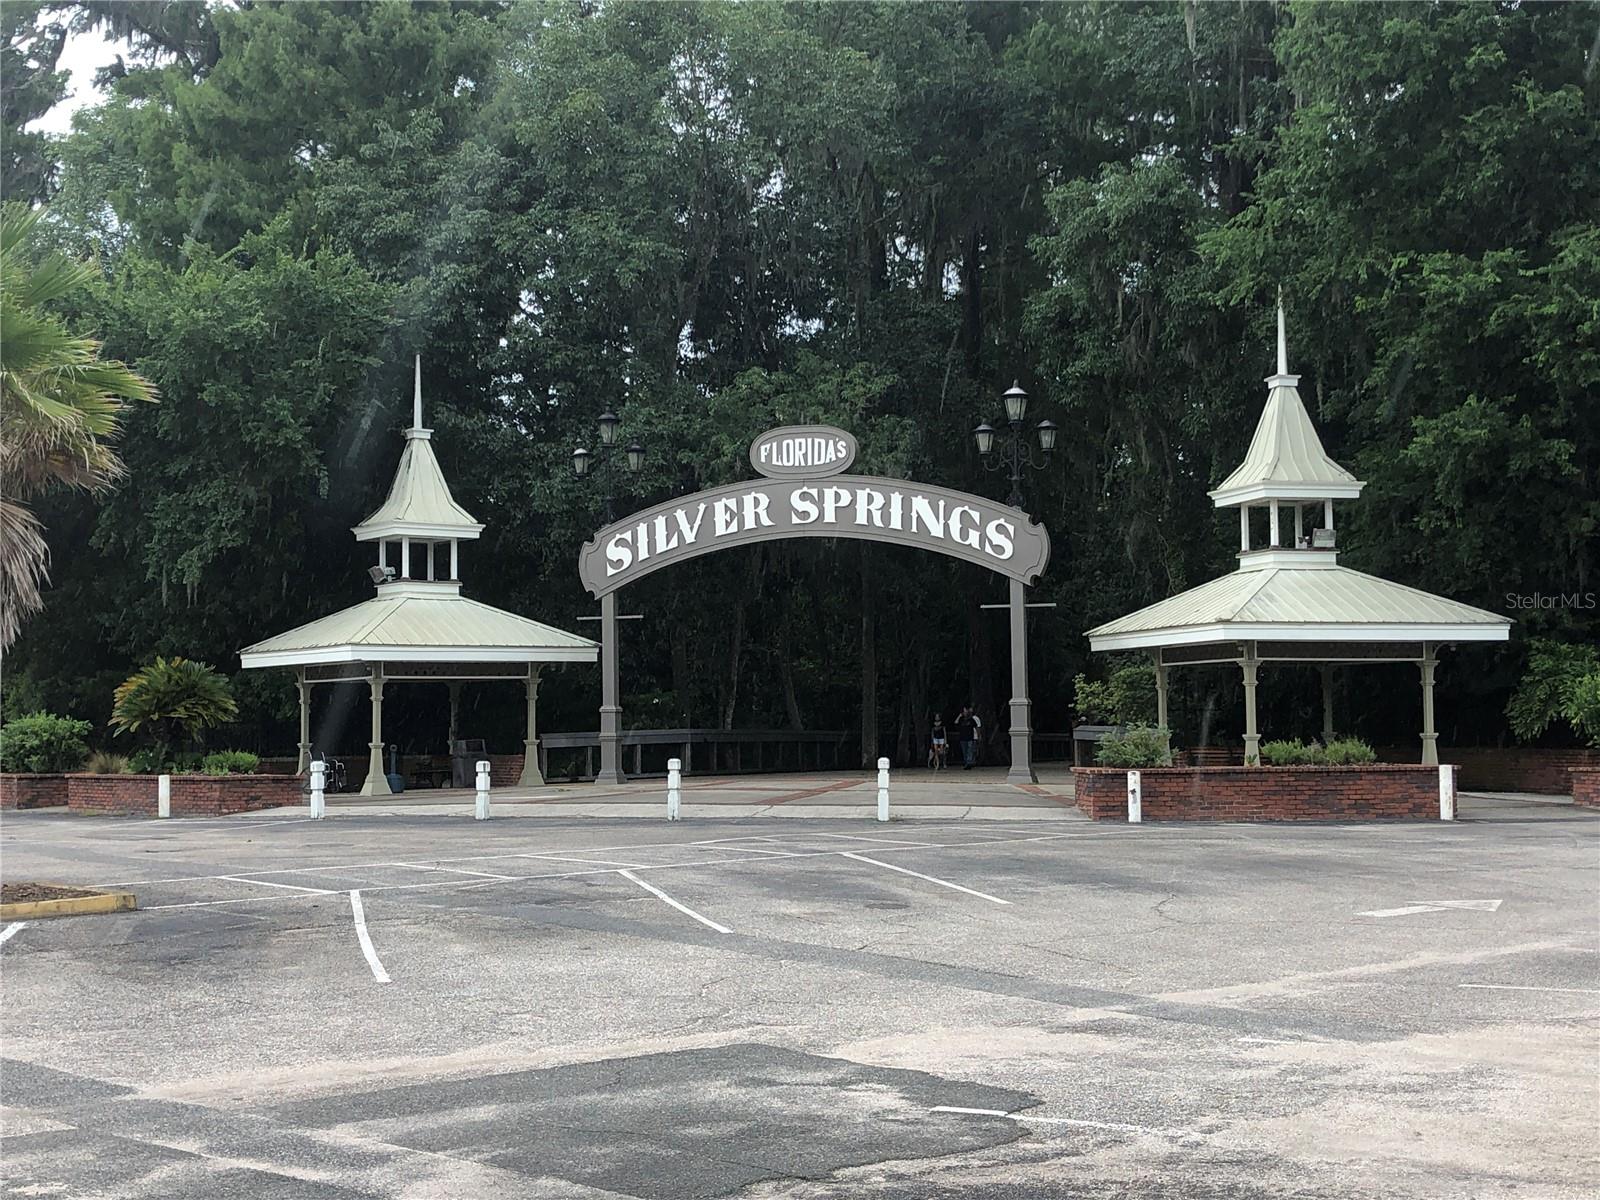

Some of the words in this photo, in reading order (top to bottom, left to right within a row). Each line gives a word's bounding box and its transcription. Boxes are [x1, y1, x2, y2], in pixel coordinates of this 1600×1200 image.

[760, 437, 847, 467] FLORIDA'S
[605, 491, 775, 577] SILVER
[790, 486, 1015, 560] SPRINGS
